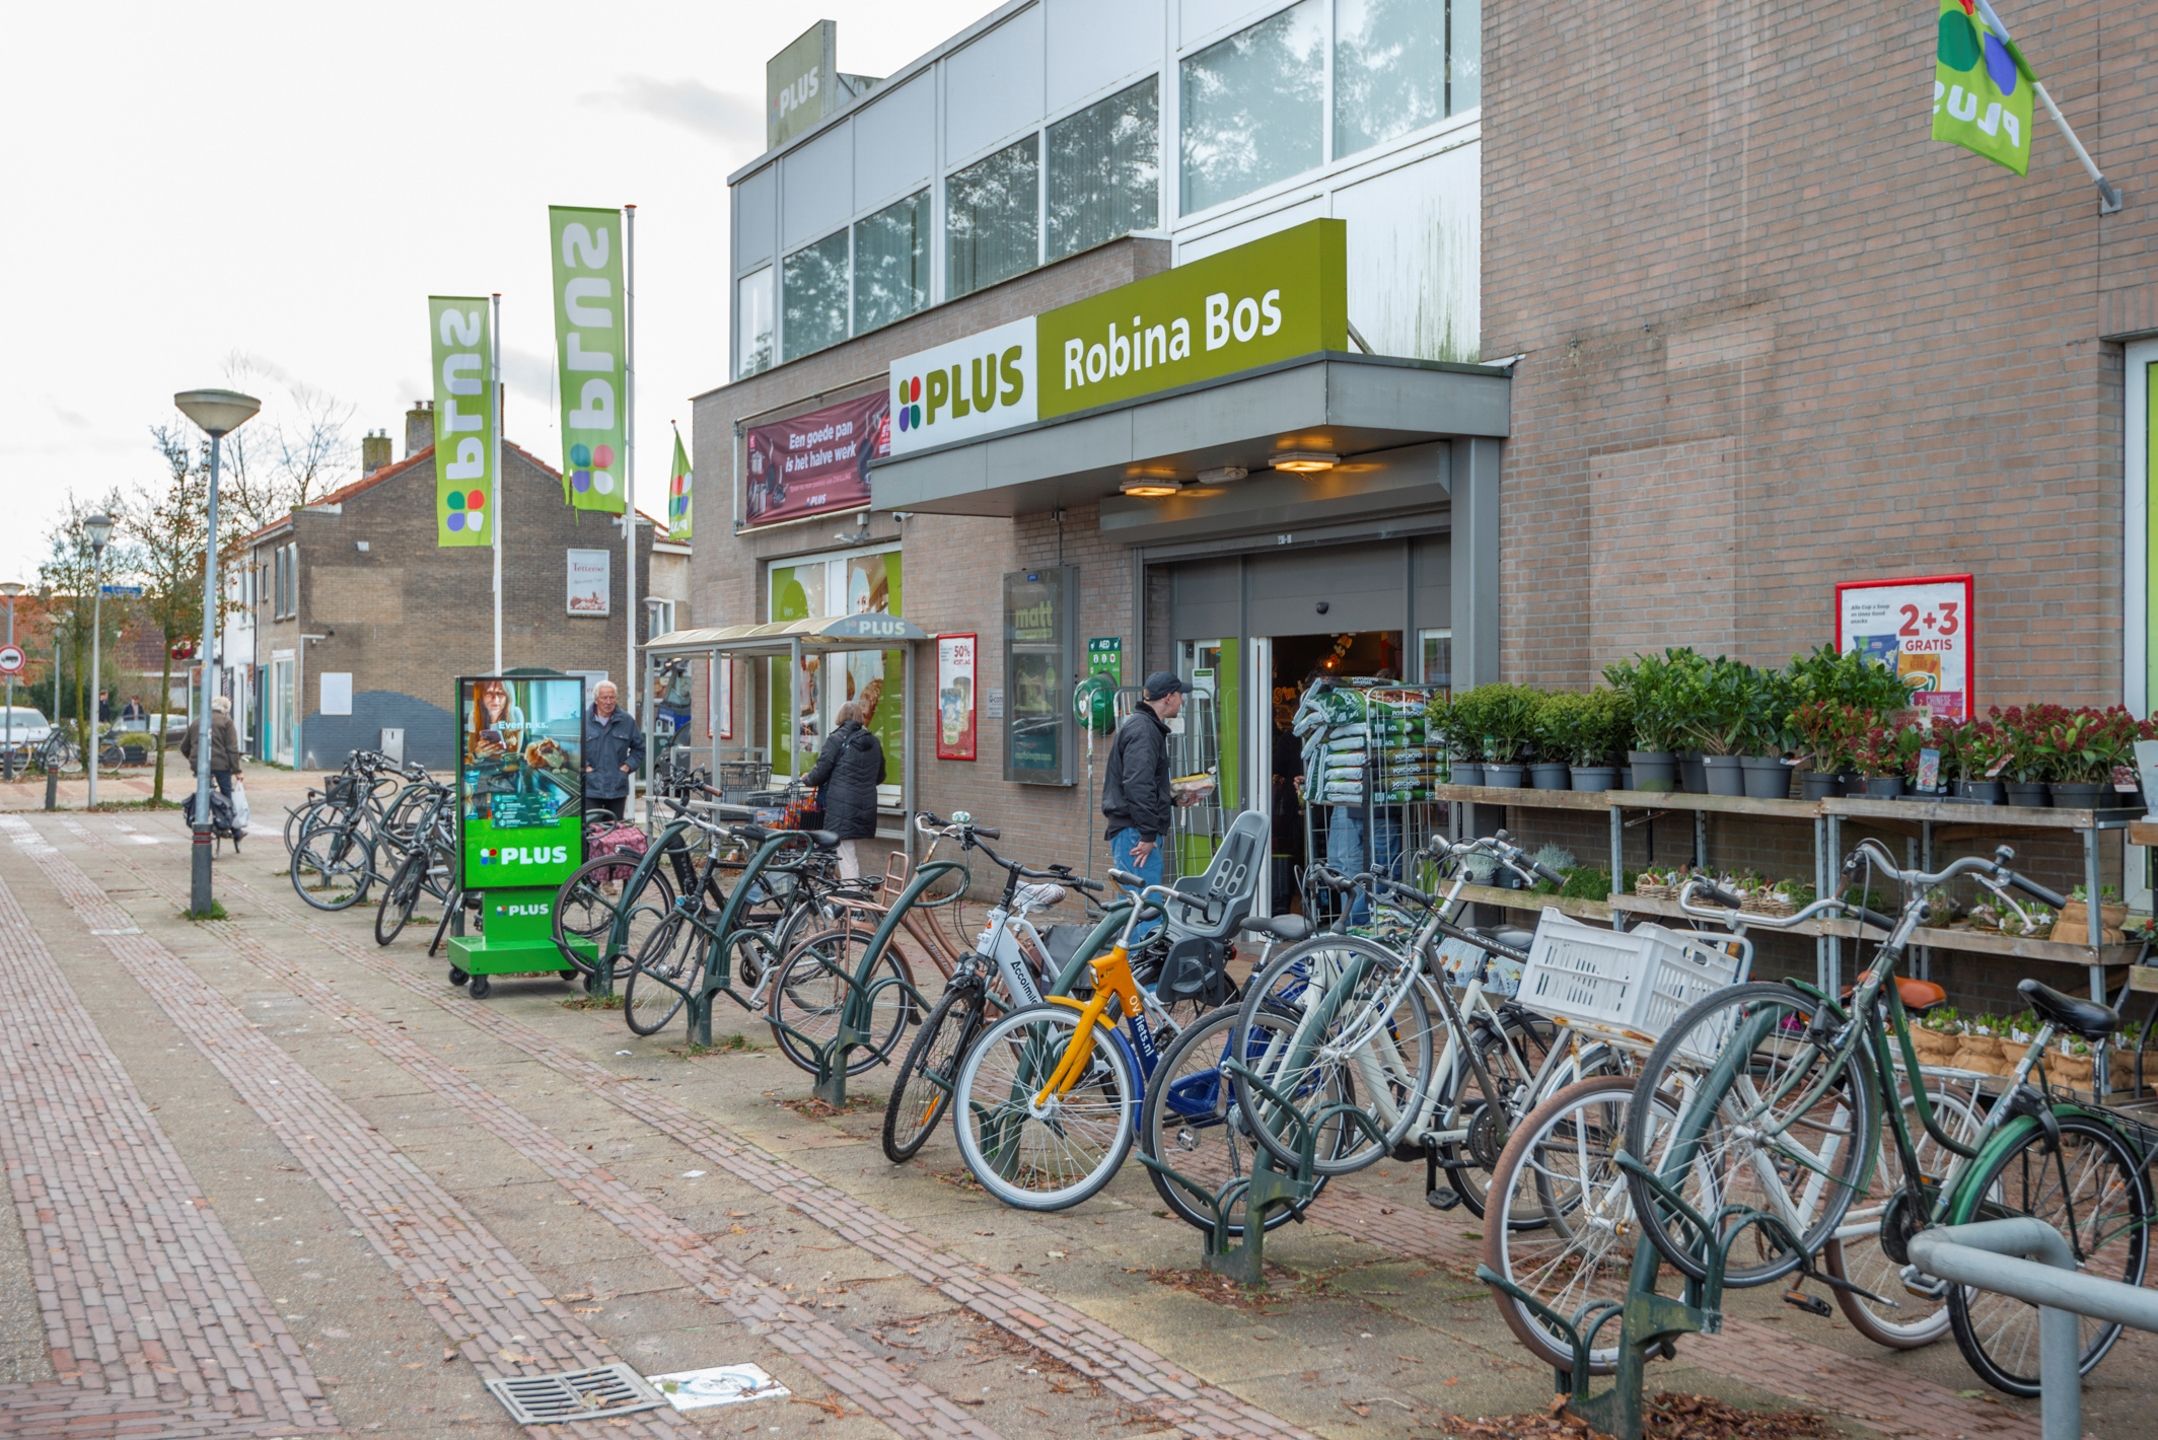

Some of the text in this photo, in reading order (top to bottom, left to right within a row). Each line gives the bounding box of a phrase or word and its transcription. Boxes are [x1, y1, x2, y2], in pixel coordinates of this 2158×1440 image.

[780, 66, 819, 119] PLUS
[926, 289, 1282, 426] PLUS Robina Bos
[789, 420, 853, 450] Een goede pan
[785, 441, 857, 473] is het halve werk
[810, 493, 827, 506] PLUS
[859, 620, 906, 635] PLUS
[1898, 602, 1959, 637] 2+3
[954, 645, 970, 658] 50%
[1905, 639, 1952, 652] GRATIS
[501, 846, 568, 865] PLUS
[508, 903, 549, 916] PLUS
[1129, 995, 1155, 1057] OV-fiets.nl
